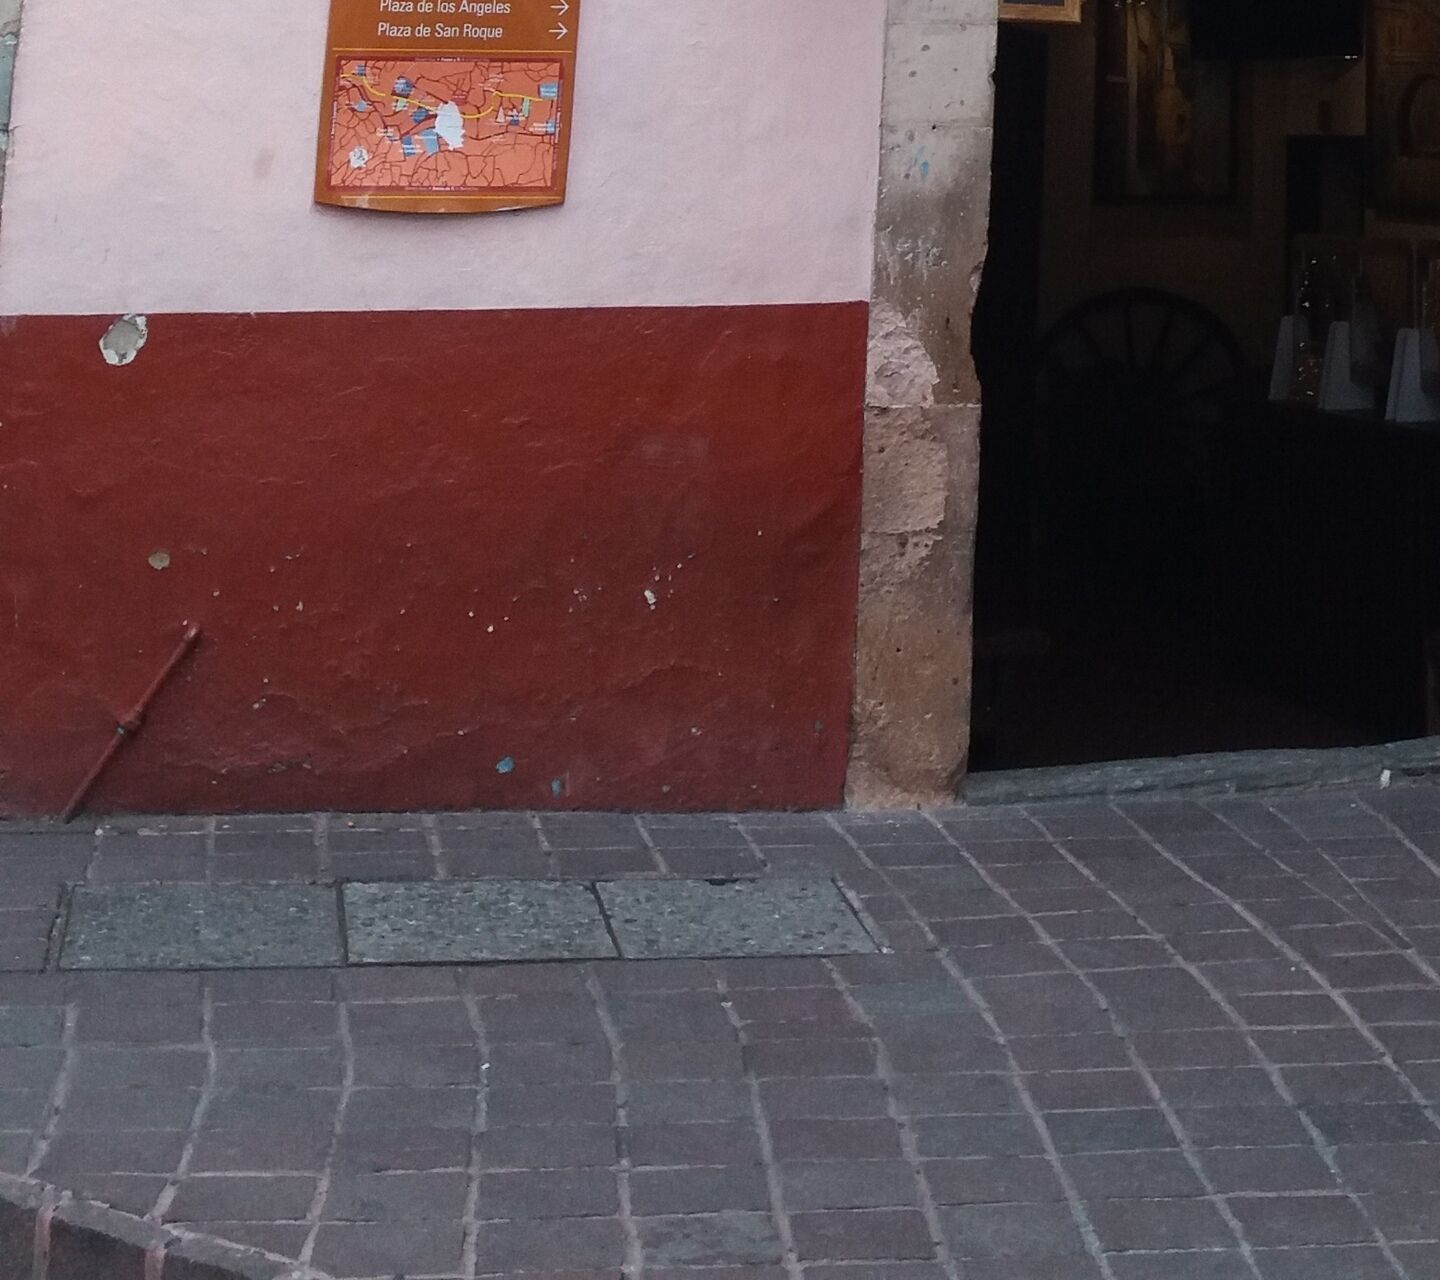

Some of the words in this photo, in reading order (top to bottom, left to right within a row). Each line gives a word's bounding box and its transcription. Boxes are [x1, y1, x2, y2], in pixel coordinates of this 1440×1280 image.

[437, 0, 456, 13] los
[377, 22, 412, 37] Plaza
[415, 23, 431, 37] de
[435, 23, 460, 37] San
[463, 23, 503, 40] Roque
